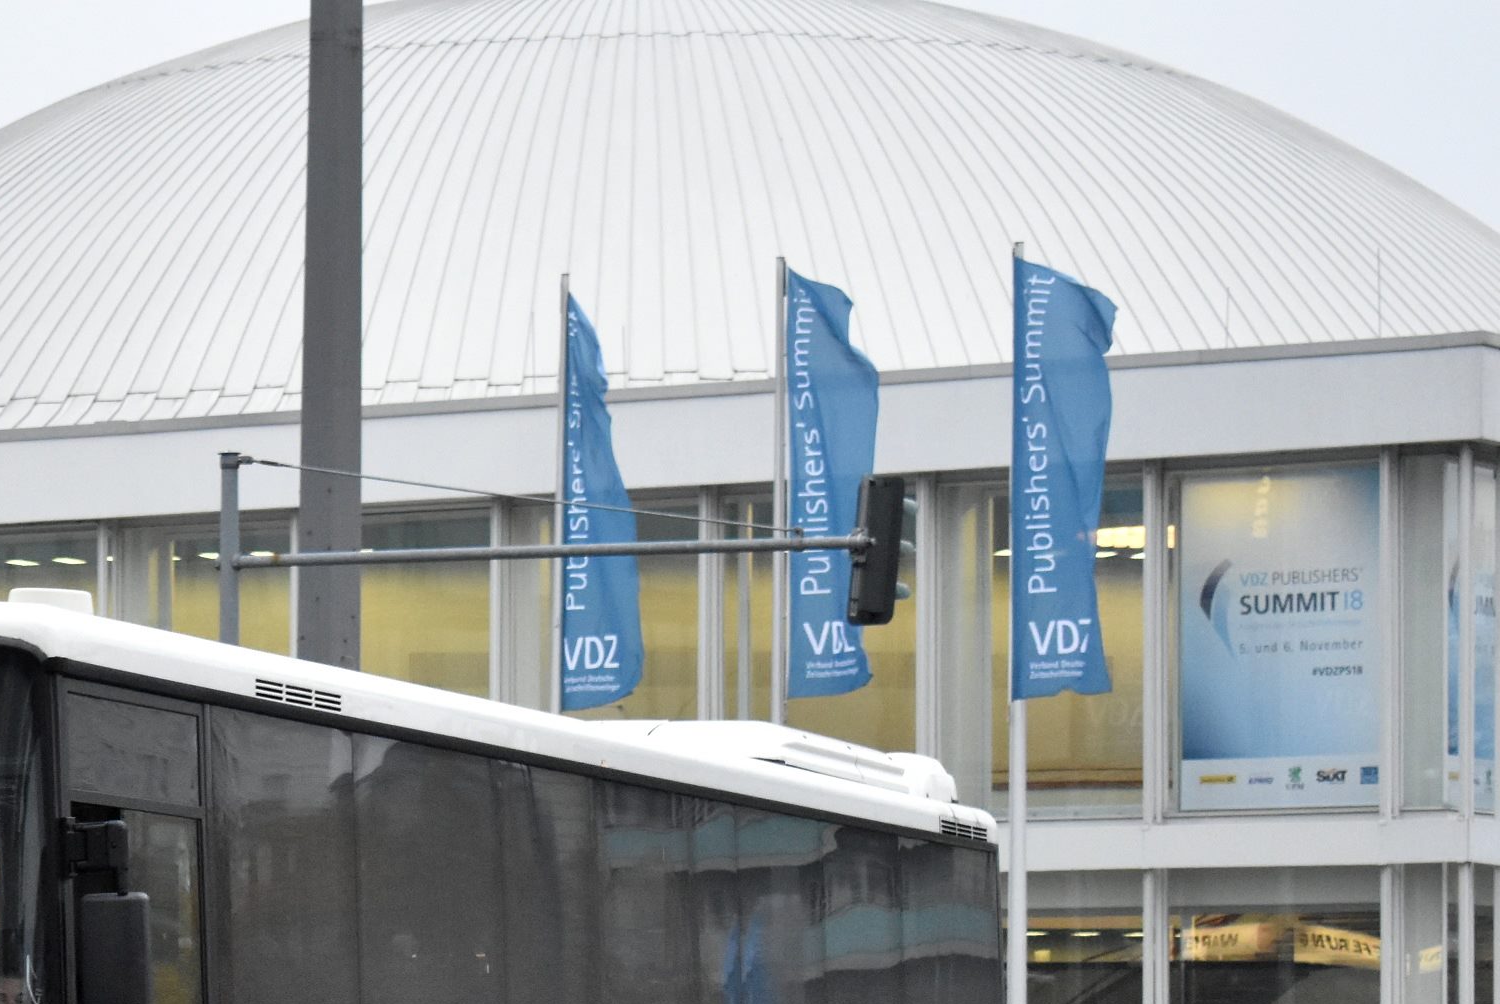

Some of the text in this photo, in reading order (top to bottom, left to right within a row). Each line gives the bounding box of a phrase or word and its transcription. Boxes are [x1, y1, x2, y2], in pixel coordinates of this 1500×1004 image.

[1021, 273, 1057, 594] Publishers' Summit
[797, 422, 832, 596] Pulishers'
[1240, 572, 1268, 587] VDZ
[1240, 590, 1363, 615] SUMMIT 18
[564, 635, 620, 671] VDZ
[1255, 641, 1278, 654] und
[1300, 639, 1363, 652] November
